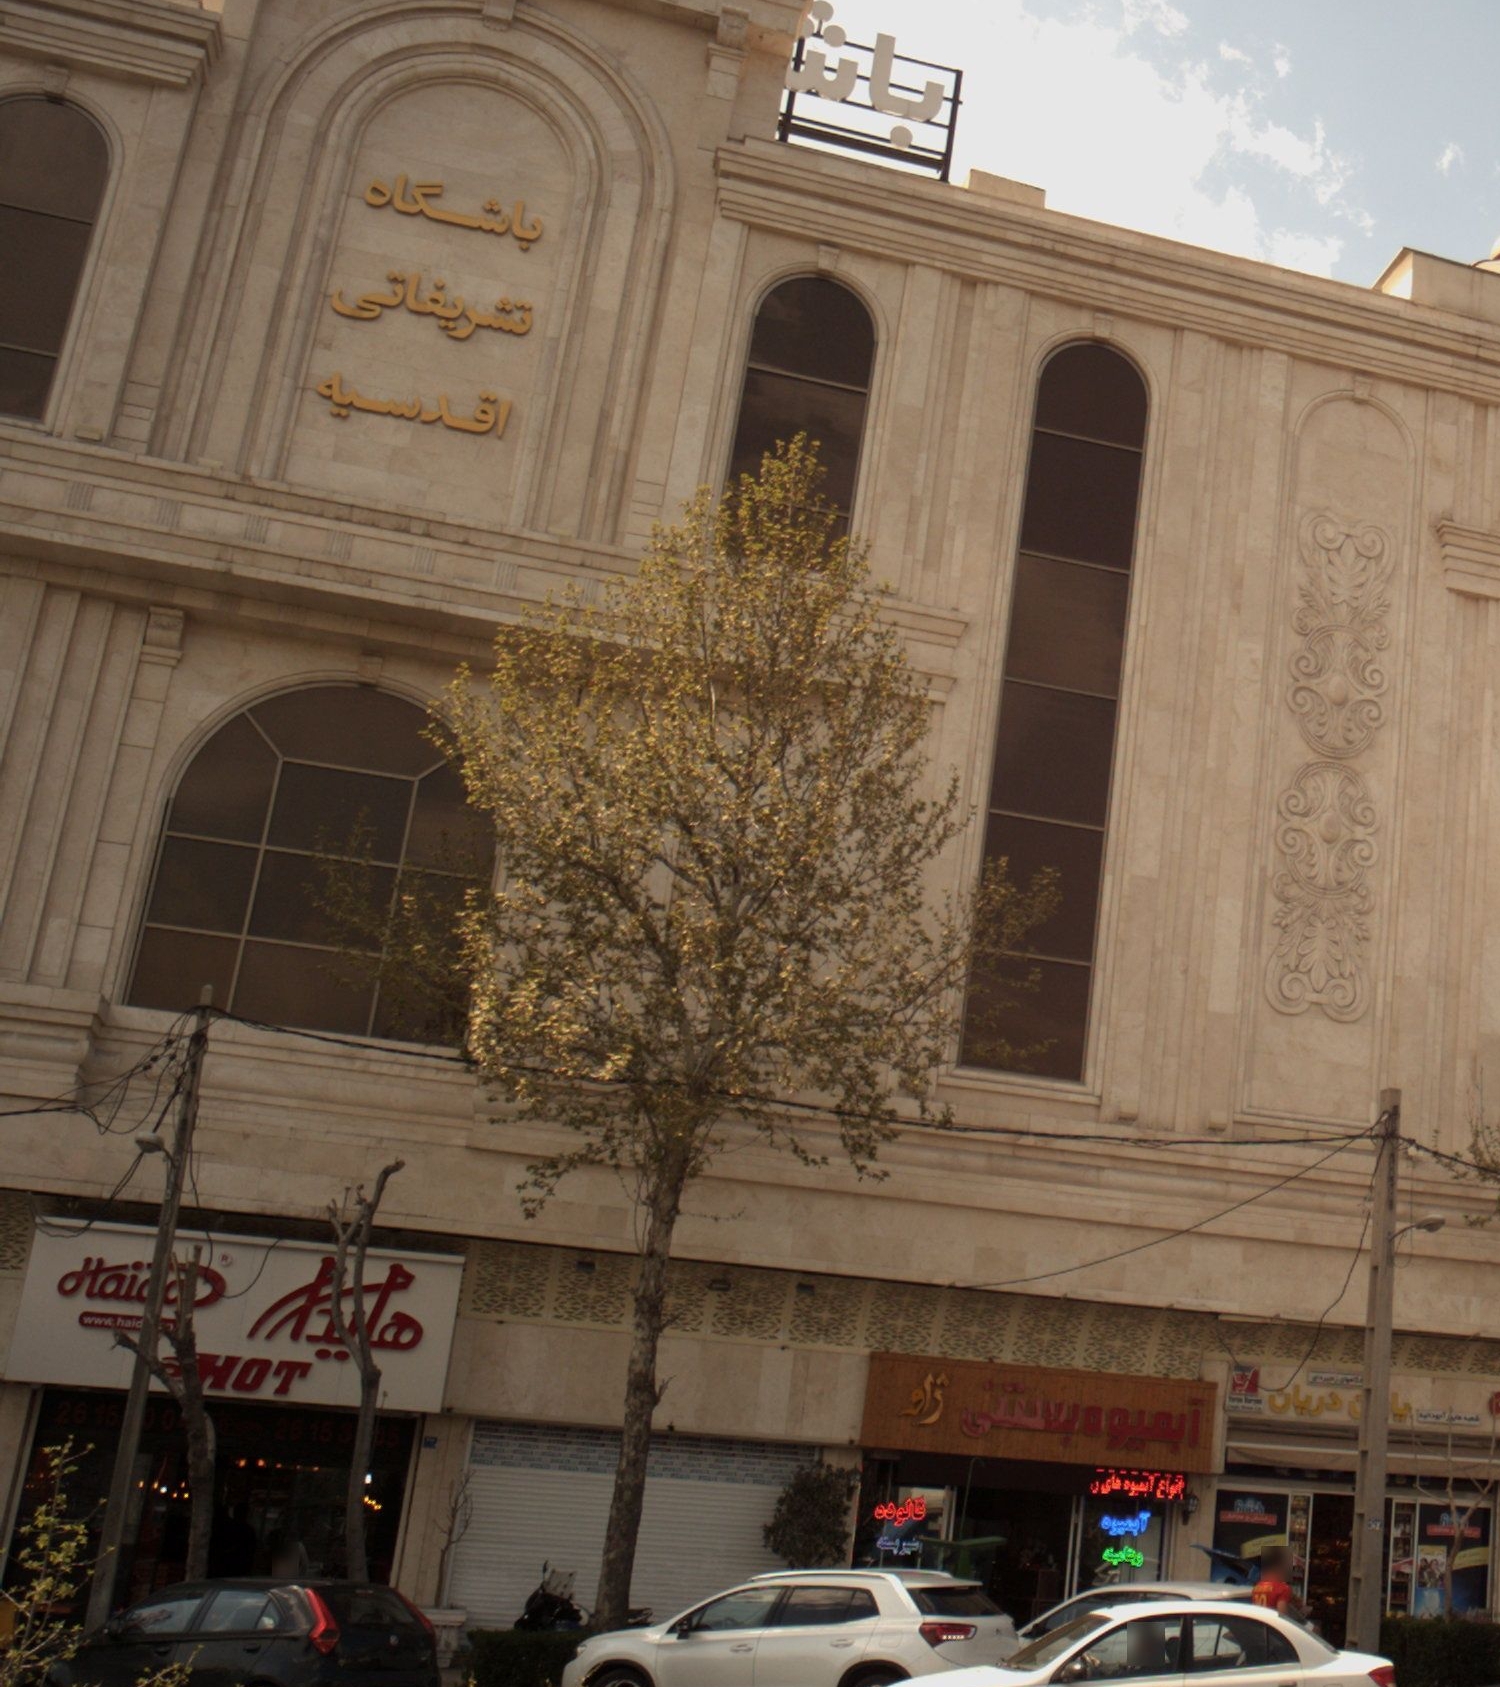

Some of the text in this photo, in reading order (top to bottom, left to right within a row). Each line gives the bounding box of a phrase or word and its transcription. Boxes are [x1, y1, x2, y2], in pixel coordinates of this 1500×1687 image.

[786, 0, 945, 148] باش
[364, 173, 544, 252] باشگاه
[330, 269, 535, 340] تشریفاتی
[314, 370, 513, 440] اقدسیه
[961, 1378, 1208, 1453] آبمیوه بستنی
[1268, 1384, 1343, 1418] دریان
[873, 1496, 928, 1528] فالوده
[1100, 1510, 1152, 1537] آبمیوه
